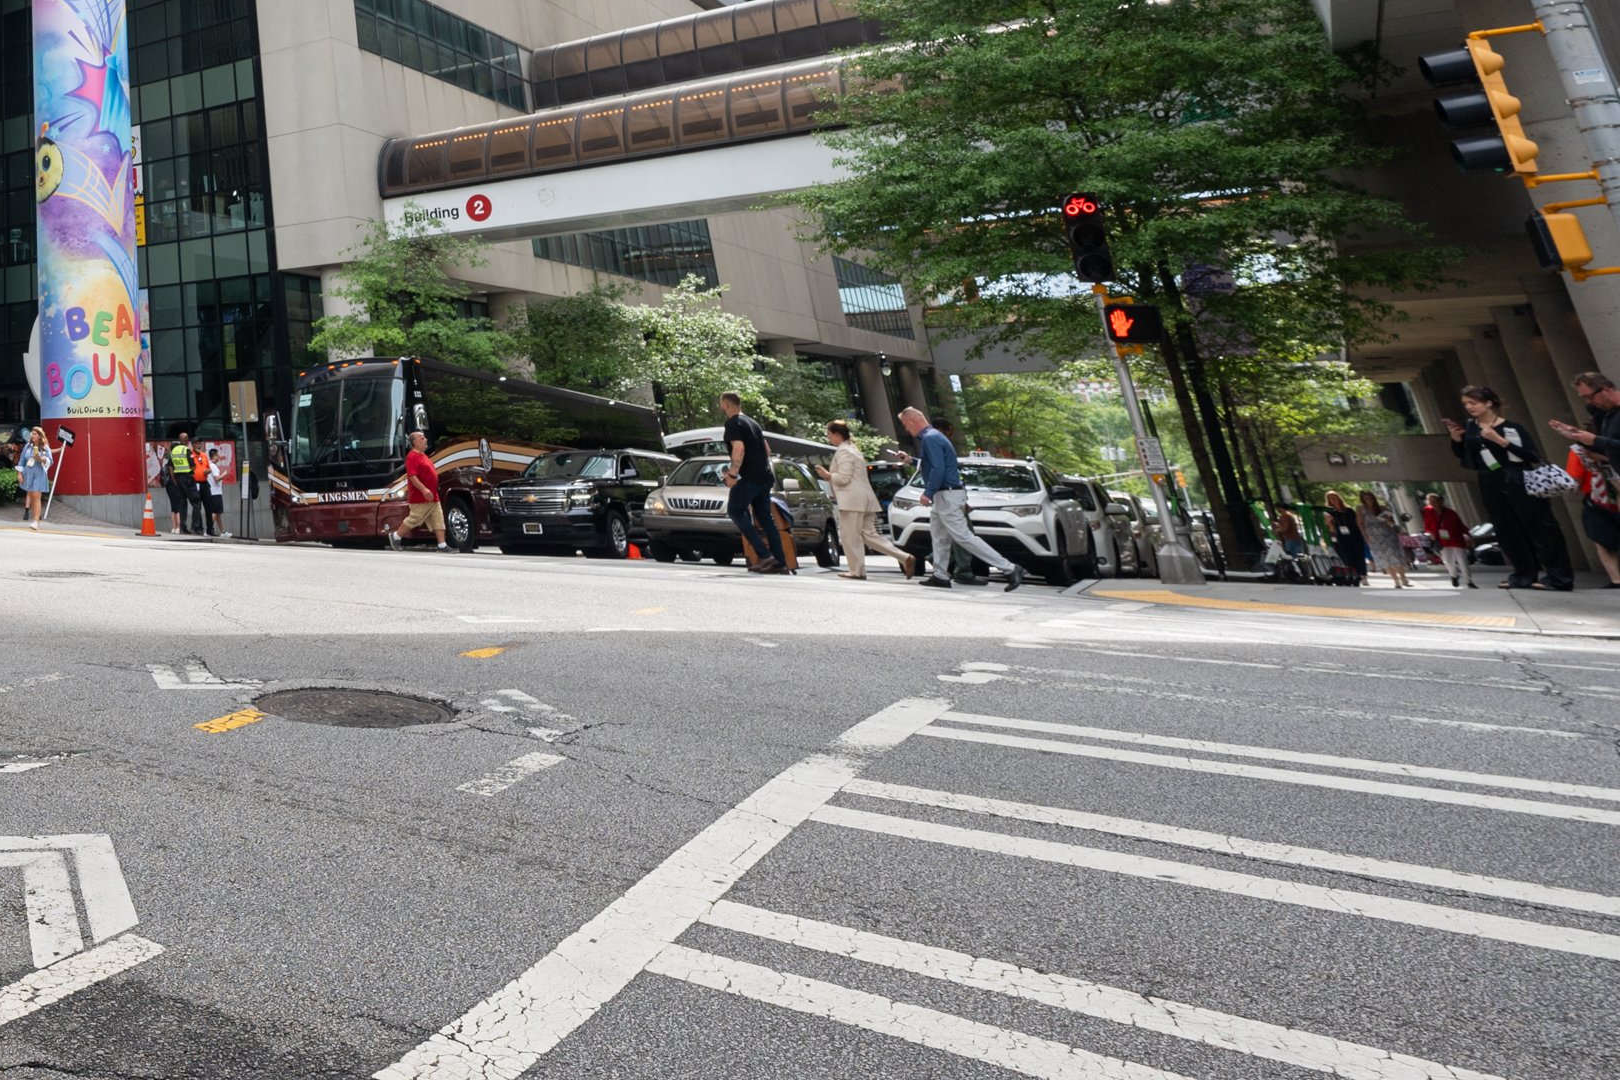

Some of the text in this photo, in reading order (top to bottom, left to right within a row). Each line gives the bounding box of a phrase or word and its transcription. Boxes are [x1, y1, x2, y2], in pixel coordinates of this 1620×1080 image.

[404, 200, 484, 223] Building 2
[317, 490, 369, 503] KINGSMEN
